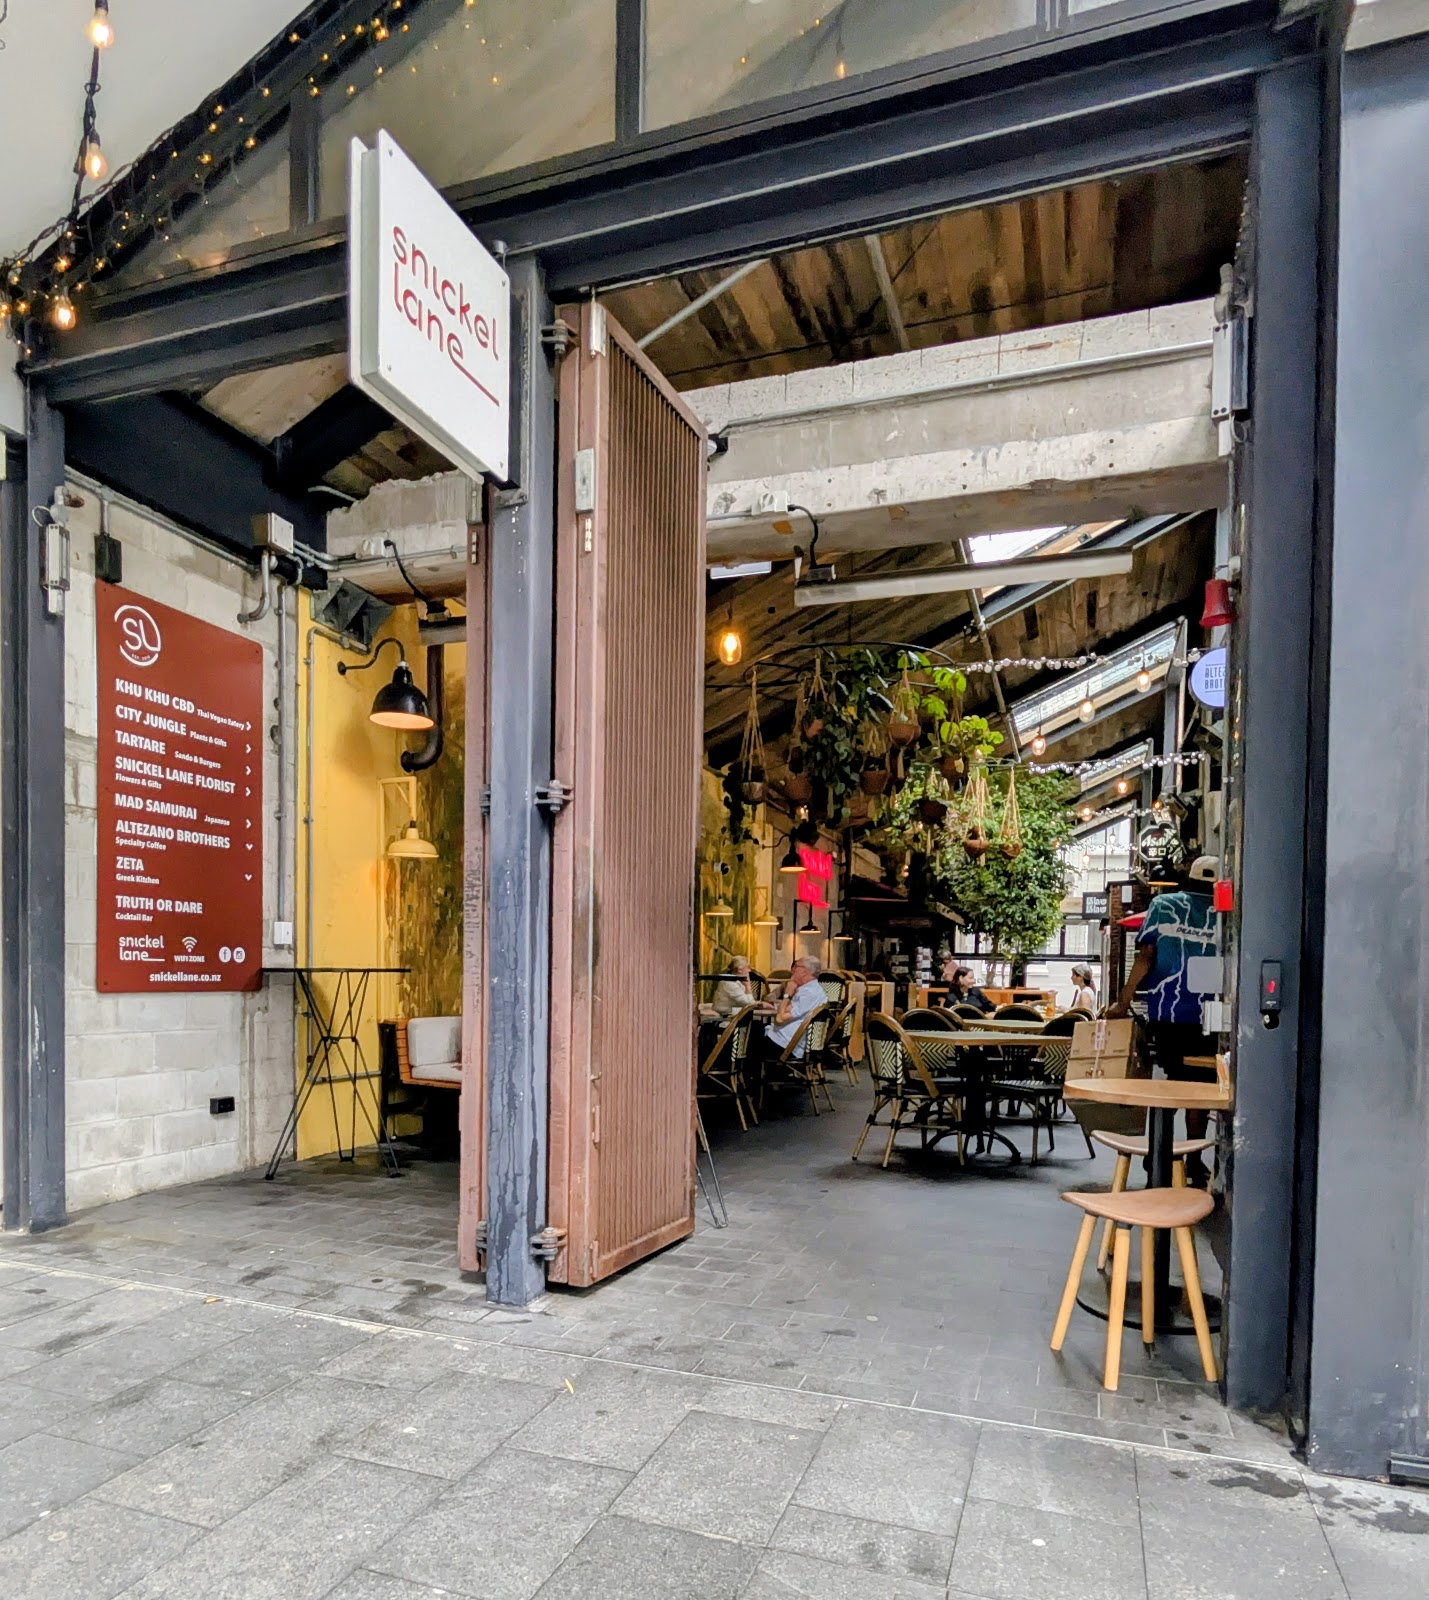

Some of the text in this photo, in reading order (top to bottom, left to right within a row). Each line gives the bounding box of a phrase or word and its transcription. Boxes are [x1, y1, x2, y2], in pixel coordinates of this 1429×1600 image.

[393, 226, 499, 361] snickel
[394, 262, 500, 407] lane
[1205, 679, 1225, 690] BROT
[115, 678, 245, 731] KHU KHU CBD Thai Vegan Eatery
[115, 704, 227, 747] CITY JUNGLE Plants & Gifts
[115, 730, 166, 755] TARTARE
[199, 757, 221, 769] Burgers
[115, 756, 236, 794] SNICKEL LANE FLORIST
[115, 773, 162, 790] Flowers & Gifts
[115, 793, 230, 826] MAD SAMURAI Japanese
[115, 819, 230, 849] ALTEZANO BROTHERS
[115, 836, 166, 851] Specialty Coffee
[116, 856, 144, 871] ZETA
[116, 873, 160, 885] Greek Kitchen
[115, 895, 203, 914] TRUTH OR DARE
[115, 913, 153, 922] Cocktail Bar
[119, 934, 164, 949] snickel
[119, 946, 165, 962] lane
[189, 955, 205, 963] ZONE
[149, 971, 222, 983] snickellane.co.nz
